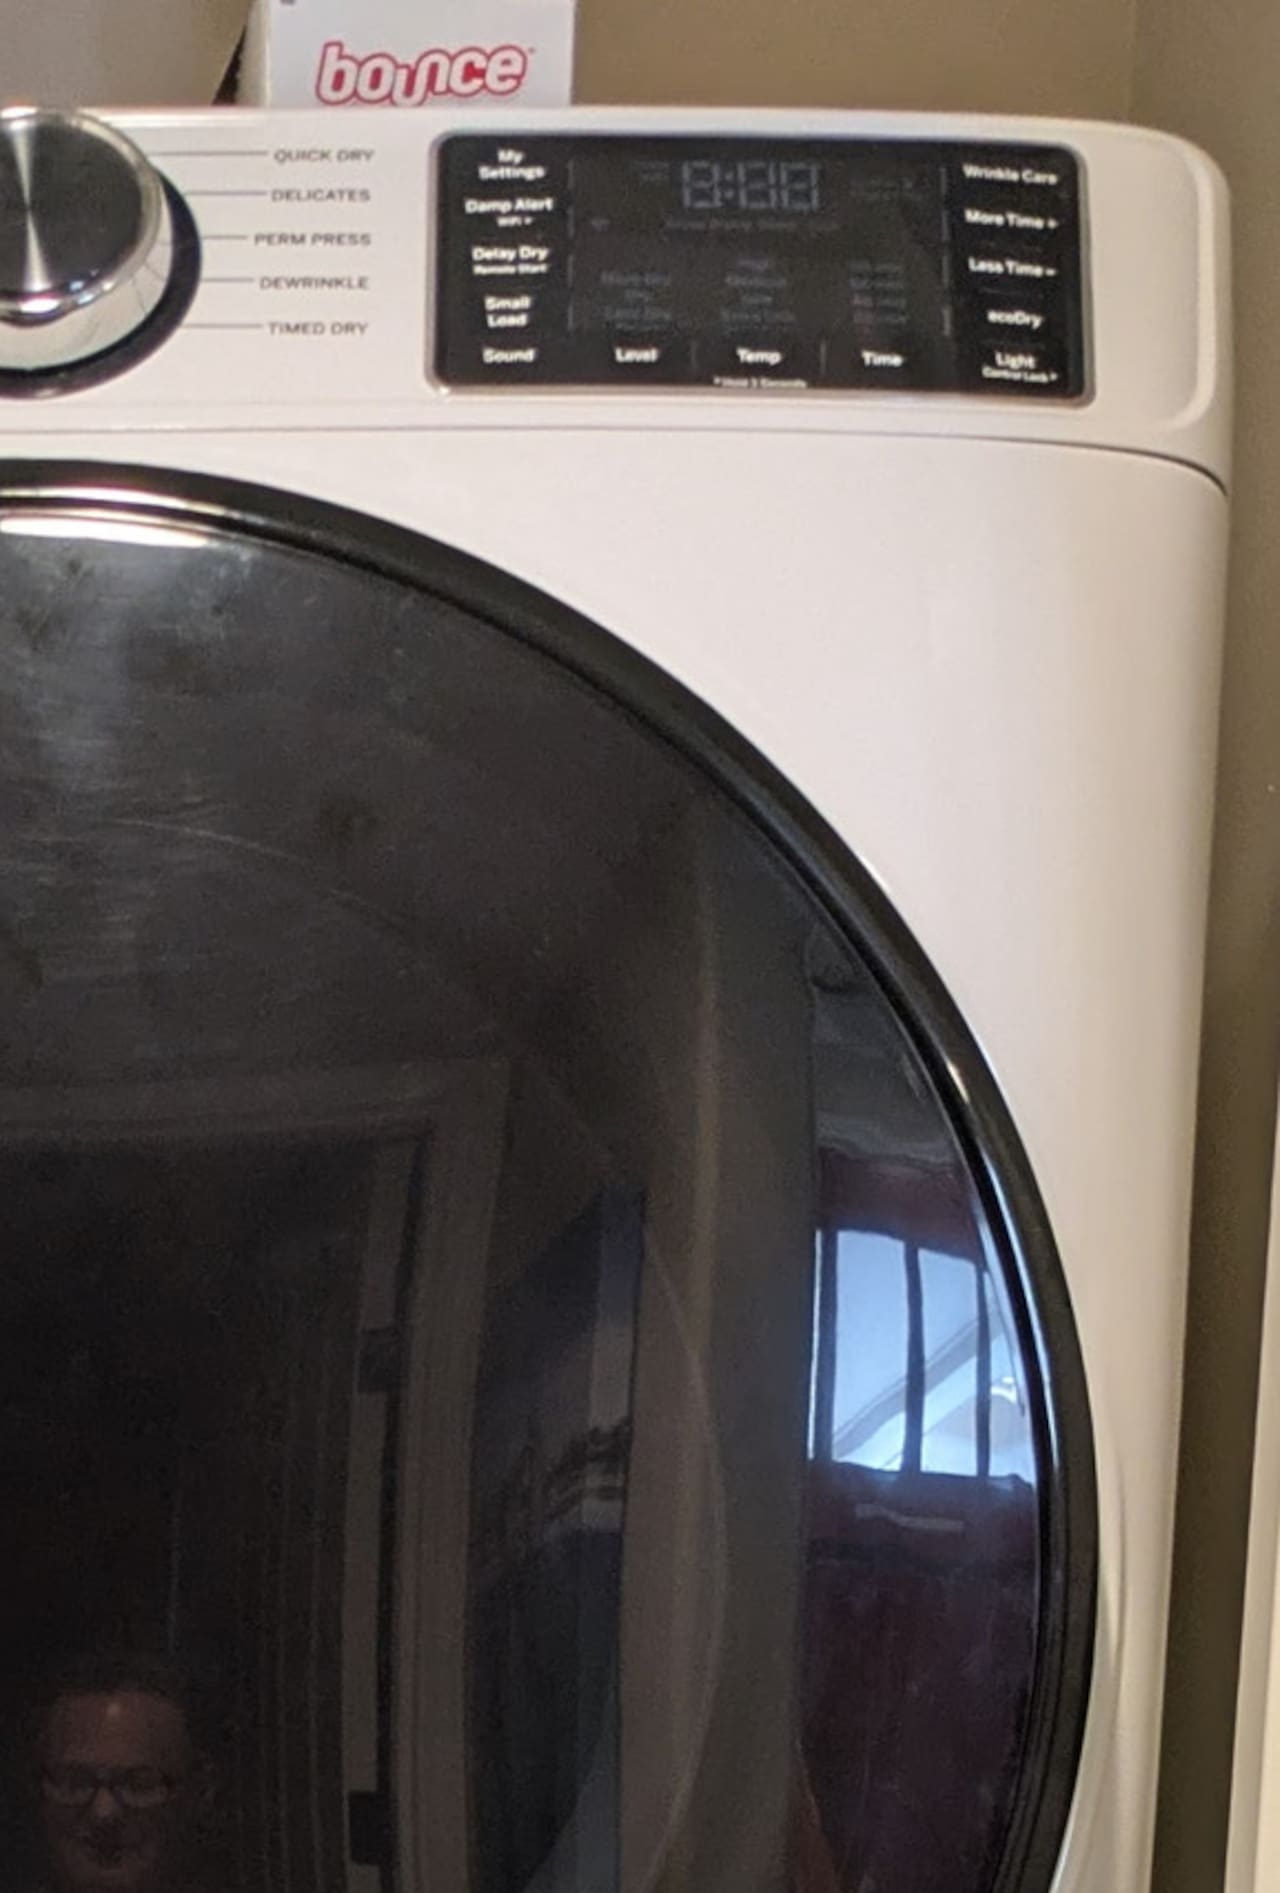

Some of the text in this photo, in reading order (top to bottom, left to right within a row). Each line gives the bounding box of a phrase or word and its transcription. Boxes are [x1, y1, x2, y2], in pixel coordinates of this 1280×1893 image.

[315, 41, 528, 107] bounce
[273, 149, 375, 164] QUICK DRY
[498, 148, 524, 165] My
[478, 165, 546, 181] Settings
[963, 163, 1058, 185] Wrinkle Care
[271, 188, 372, 202] DELICATES
[465, 197, 554, 213] Damp Alert
[965, 209, 1004, 226] More
[1006, 211, 1044, 228] Time
[254, 232, 372, 246] PERM PRESS
[472, 246, 549, 261] Delay Dry
[969, 258, 1004, 274] Less
[1006, 260, 1043, 277] Time
[260, 276, 369, 290] DEWRINKLE
[485, 295, 531, 311] Small
[487, 313, 528, 327] Load
[987, 309, 1044, 329] ecoDry
[269, 321, 368, 335] TIMED DRY
[483, 347, 536, 364] Sound
[615, 347, 659, 362] Level
[736, 348, 782, 366] Temp
[862, 350, 904, 367] Time
[995, 351, 1035, 369] Light
